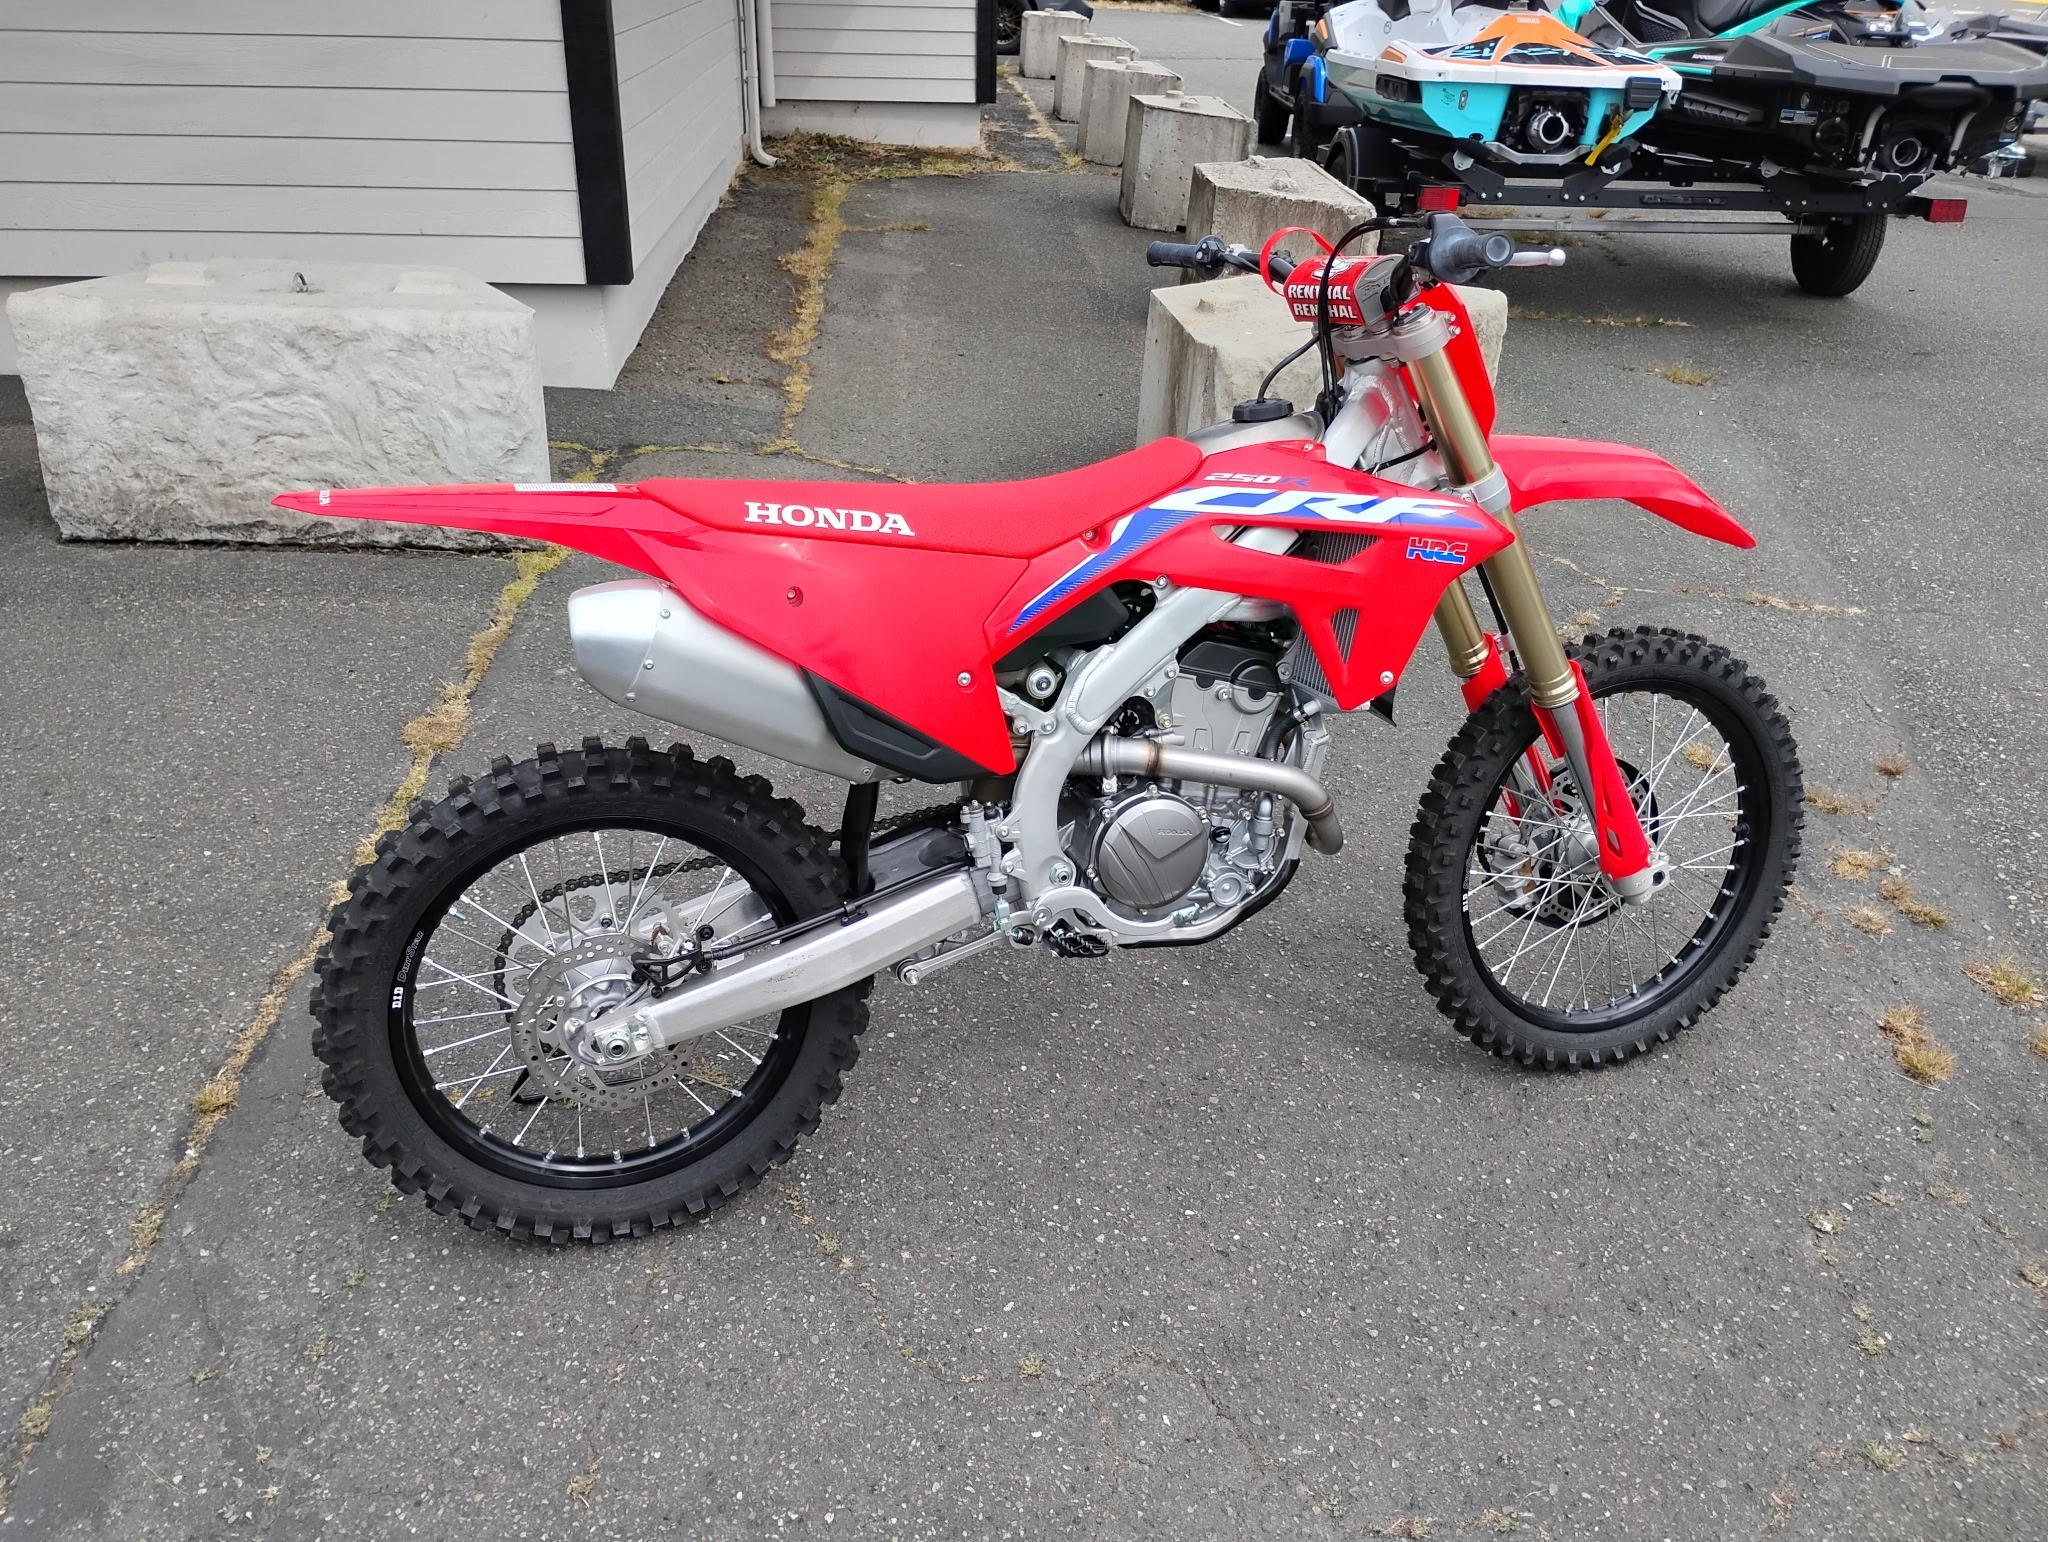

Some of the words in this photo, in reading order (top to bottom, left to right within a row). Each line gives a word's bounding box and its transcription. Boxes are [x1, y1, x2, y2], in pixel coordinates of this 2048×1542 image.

[1293, 302, 1358, 319] RENHAL
[1203, 472, 1312, 488] 250R
[744, 501, 916, 537] HONDA
[1148, 486, 1469, 524] CRF
[1406, 536, 1468, 565] HRC
